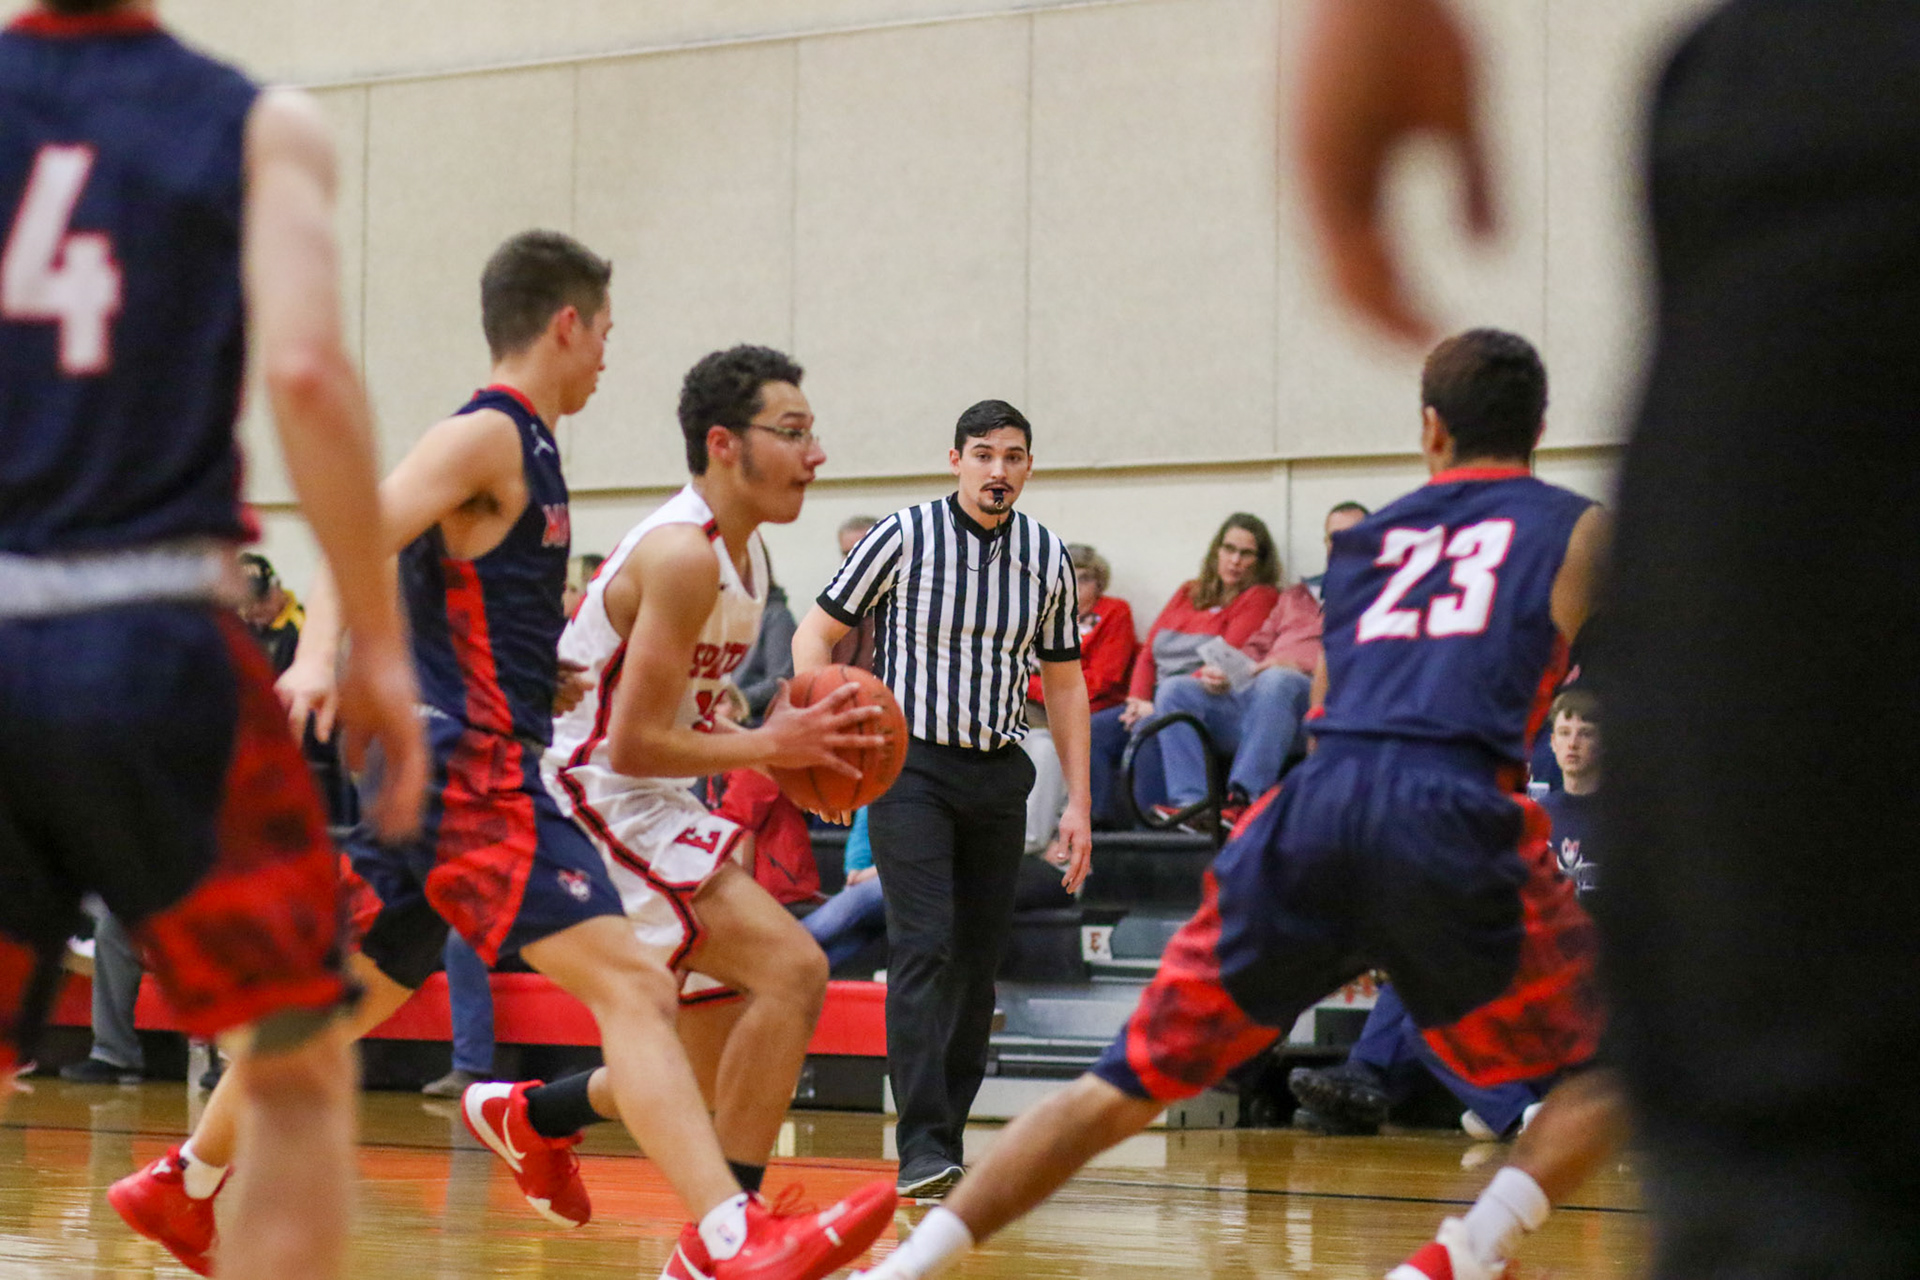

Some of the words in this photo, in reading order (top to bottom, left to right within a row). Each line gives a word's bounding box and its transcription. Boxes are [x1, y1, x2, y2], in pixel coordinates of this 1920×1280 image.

[0, 143, 124, 375] 4
[1355, 517, 1516, 644] 23
[673, 826, 722, 855] E
